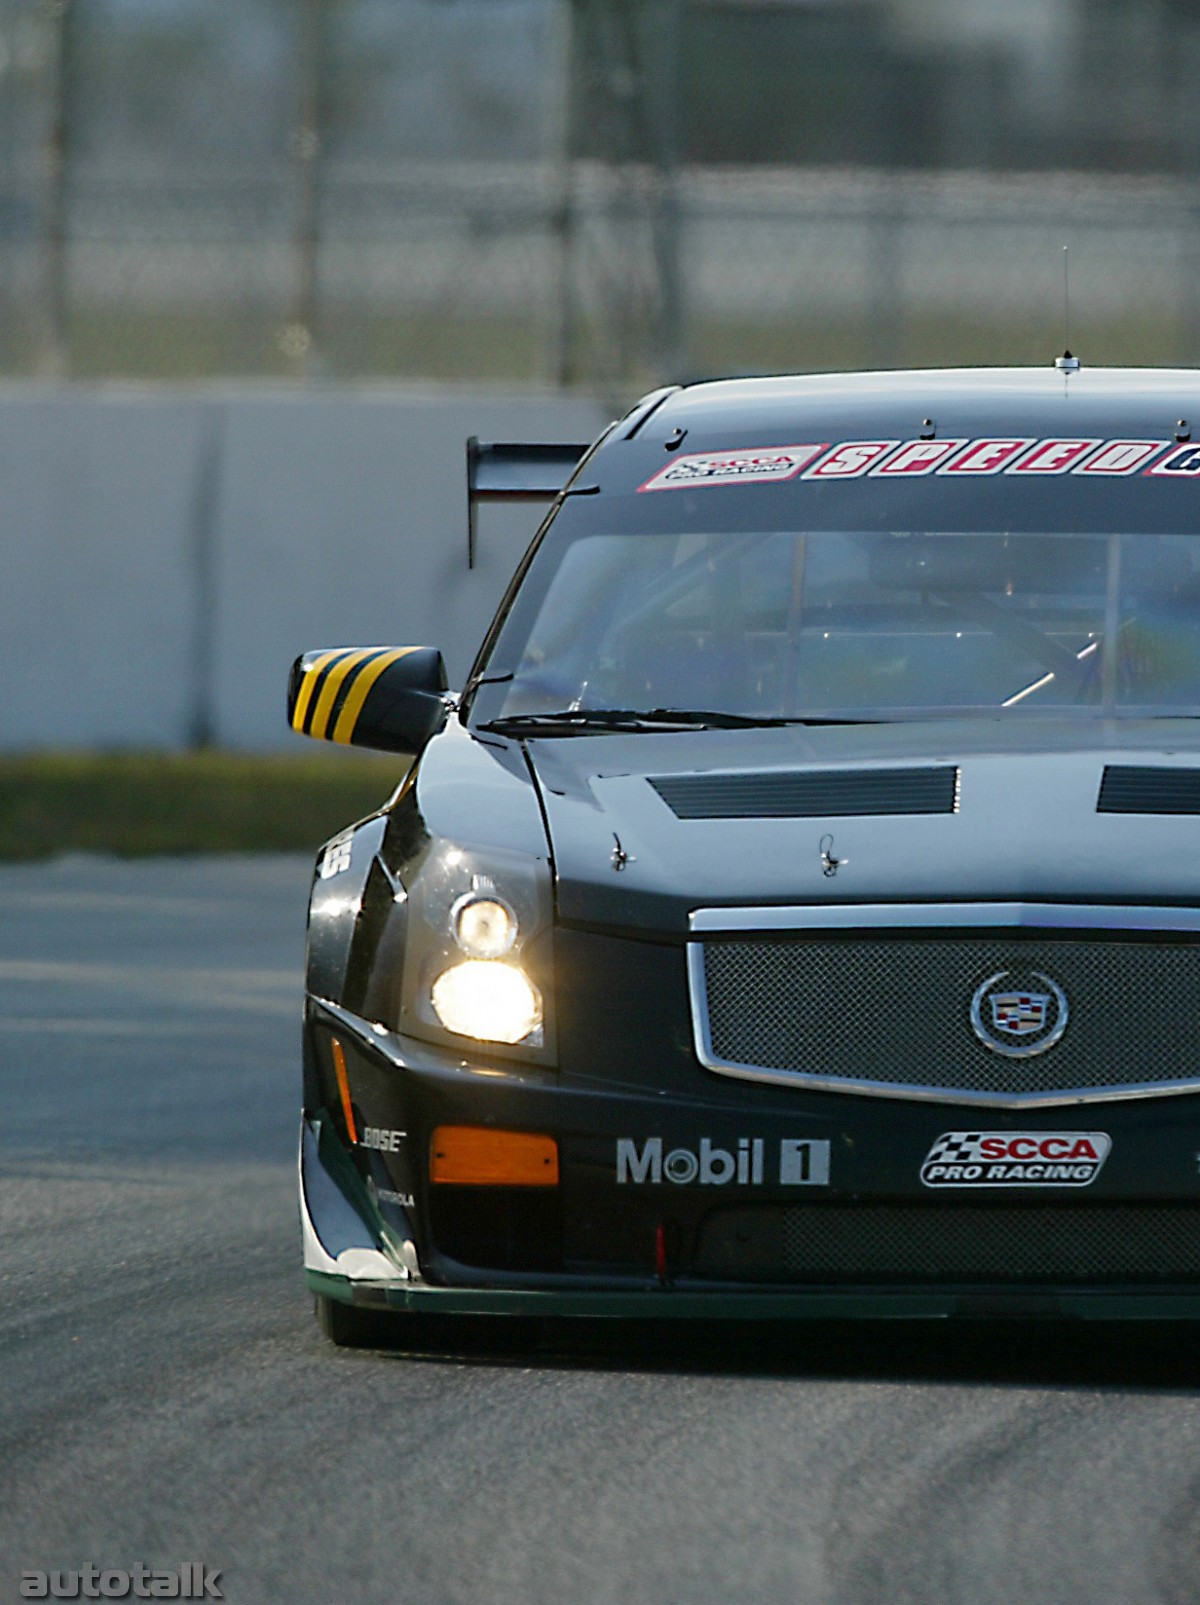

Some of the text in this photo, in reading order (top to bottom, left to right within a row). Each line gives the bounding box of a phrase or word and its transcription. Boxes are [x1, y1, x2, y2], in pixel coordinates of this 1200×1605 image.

[360, 1127, 407, 1152] BOSE
[980, 1138, 1098, 1160] SCCA
[616, 1138, 764, 1185] Mobil
[926, 1164, 1093, 1180] PRO RACING
